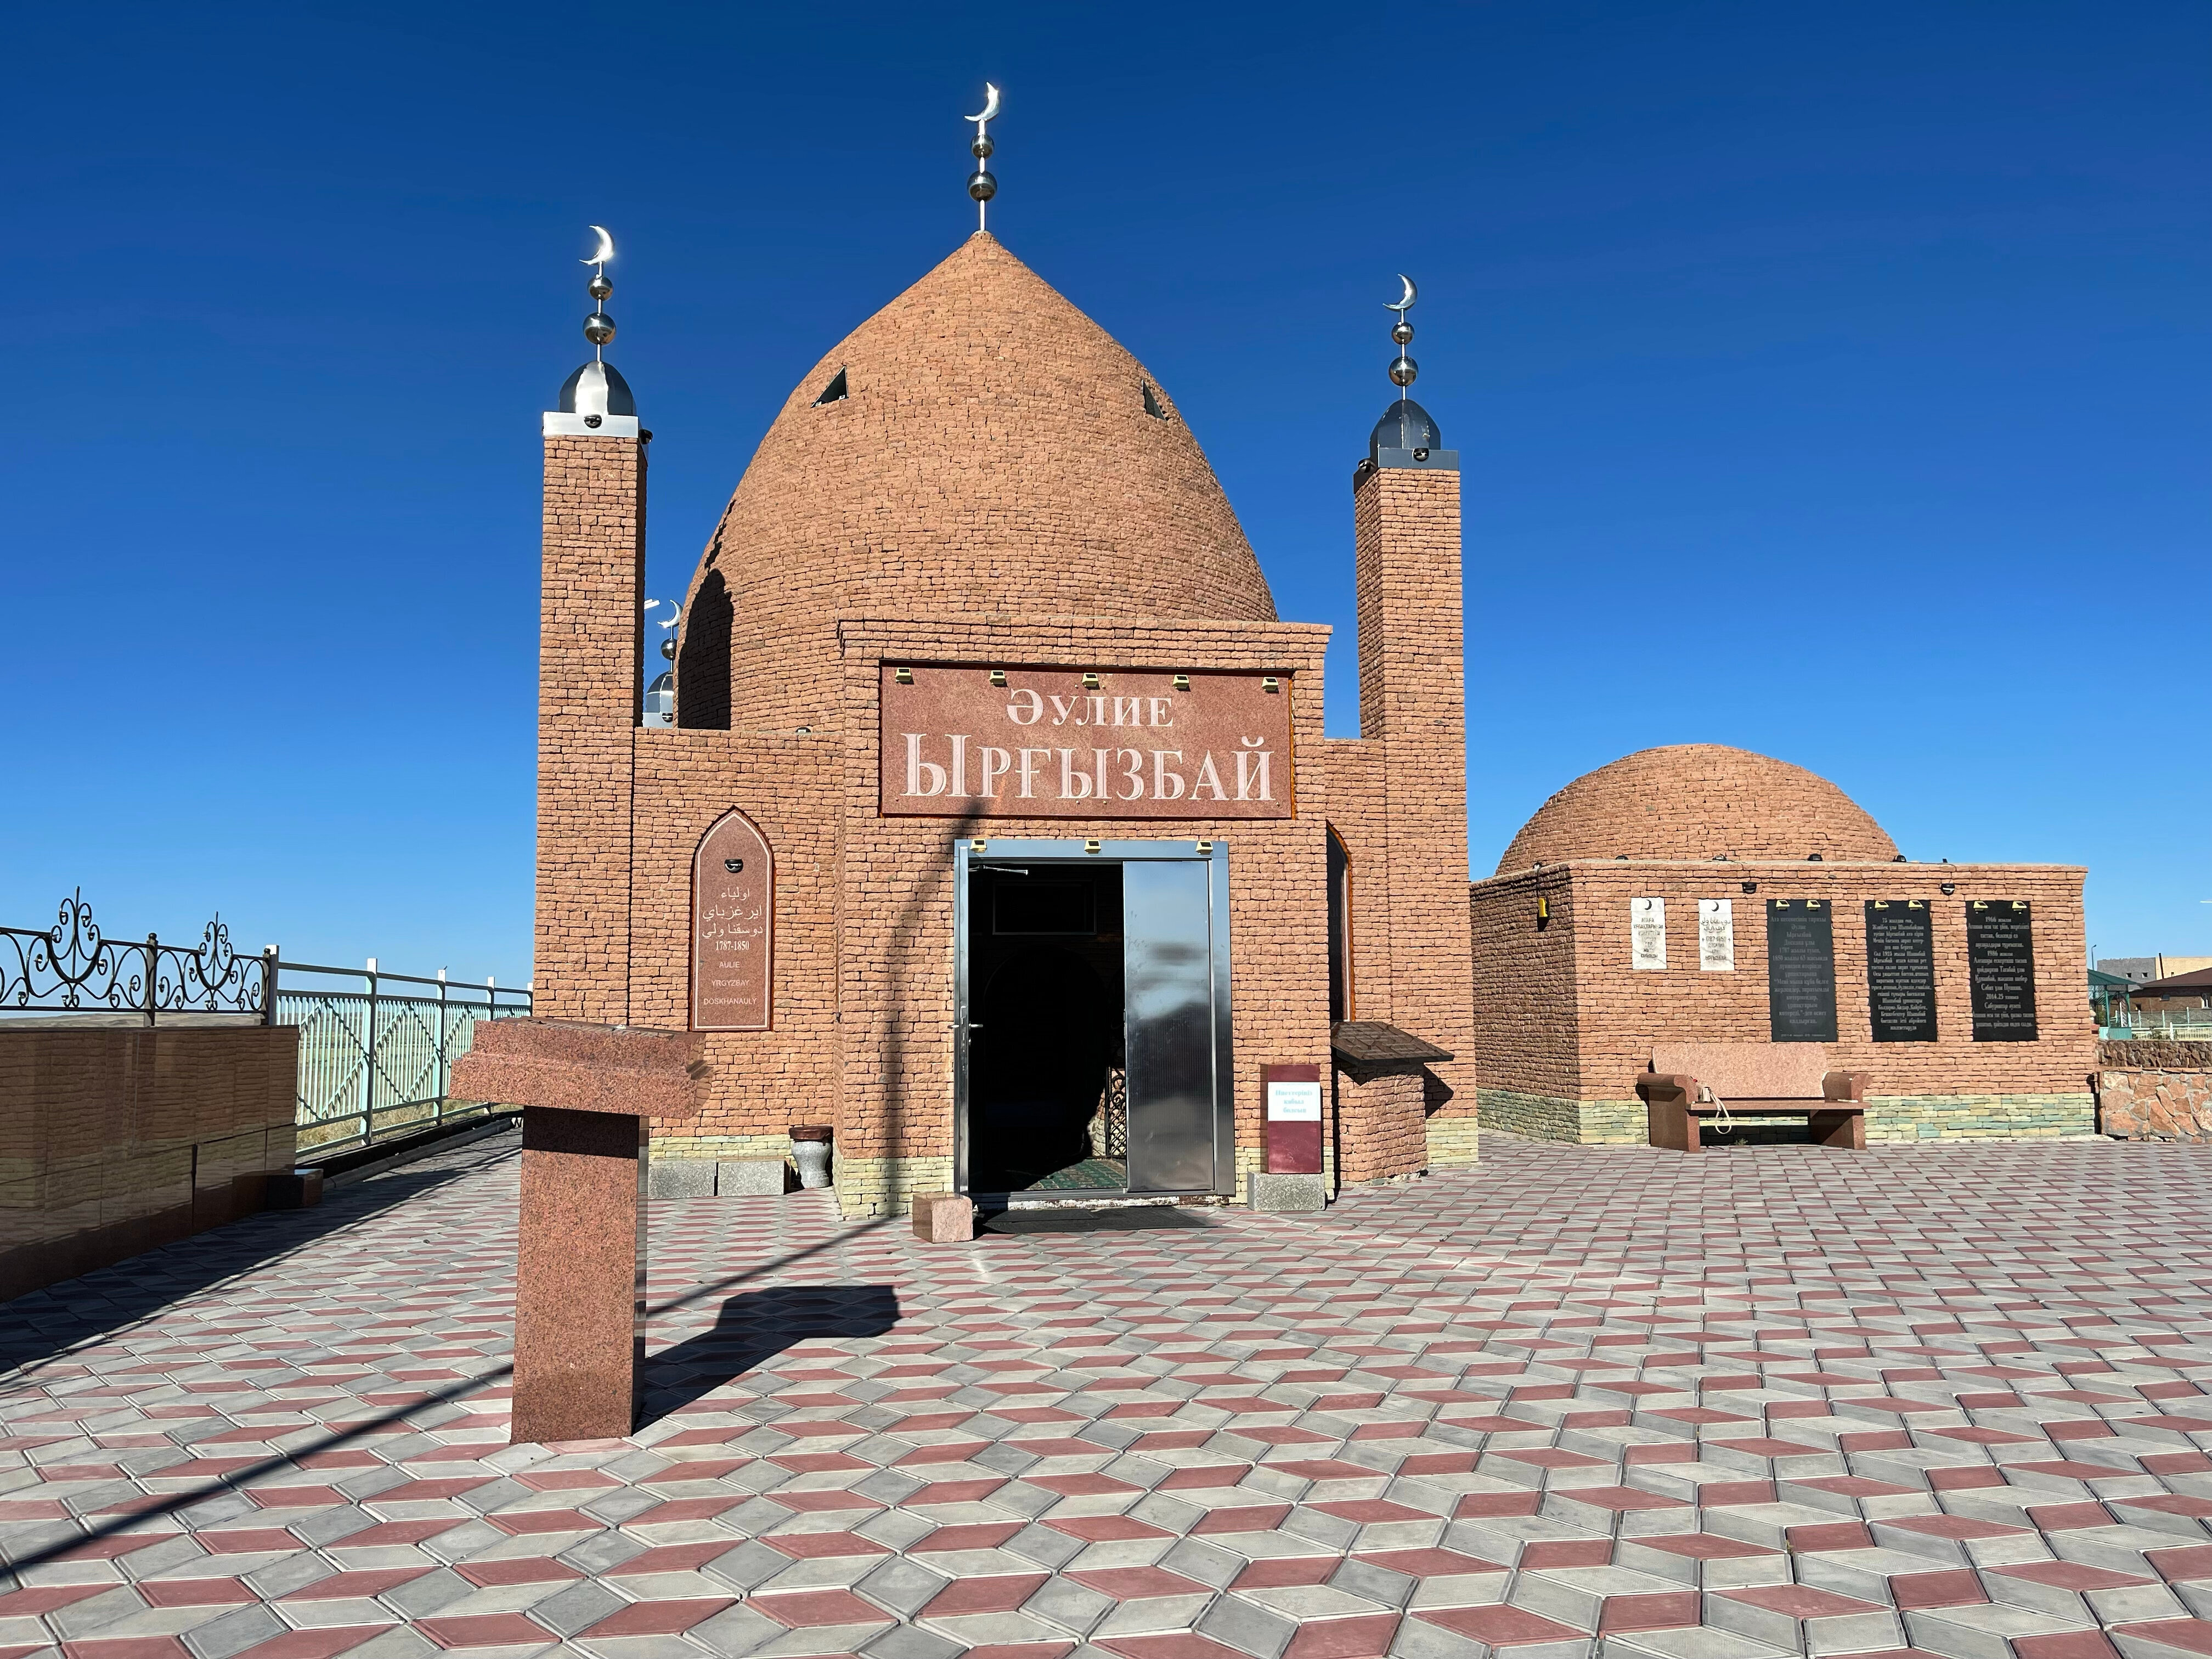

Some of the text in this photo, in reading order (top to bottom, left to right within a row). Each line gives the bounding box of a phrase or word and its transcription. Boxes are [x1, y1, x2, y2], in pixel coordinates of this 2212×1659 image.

[1006, 688, 1174, 727] ӘУЛИЕ
[900, 733, 1276, 802] ЫРҒЫЗБАЙ
[715, 941, 749, 950] 1787-1850
